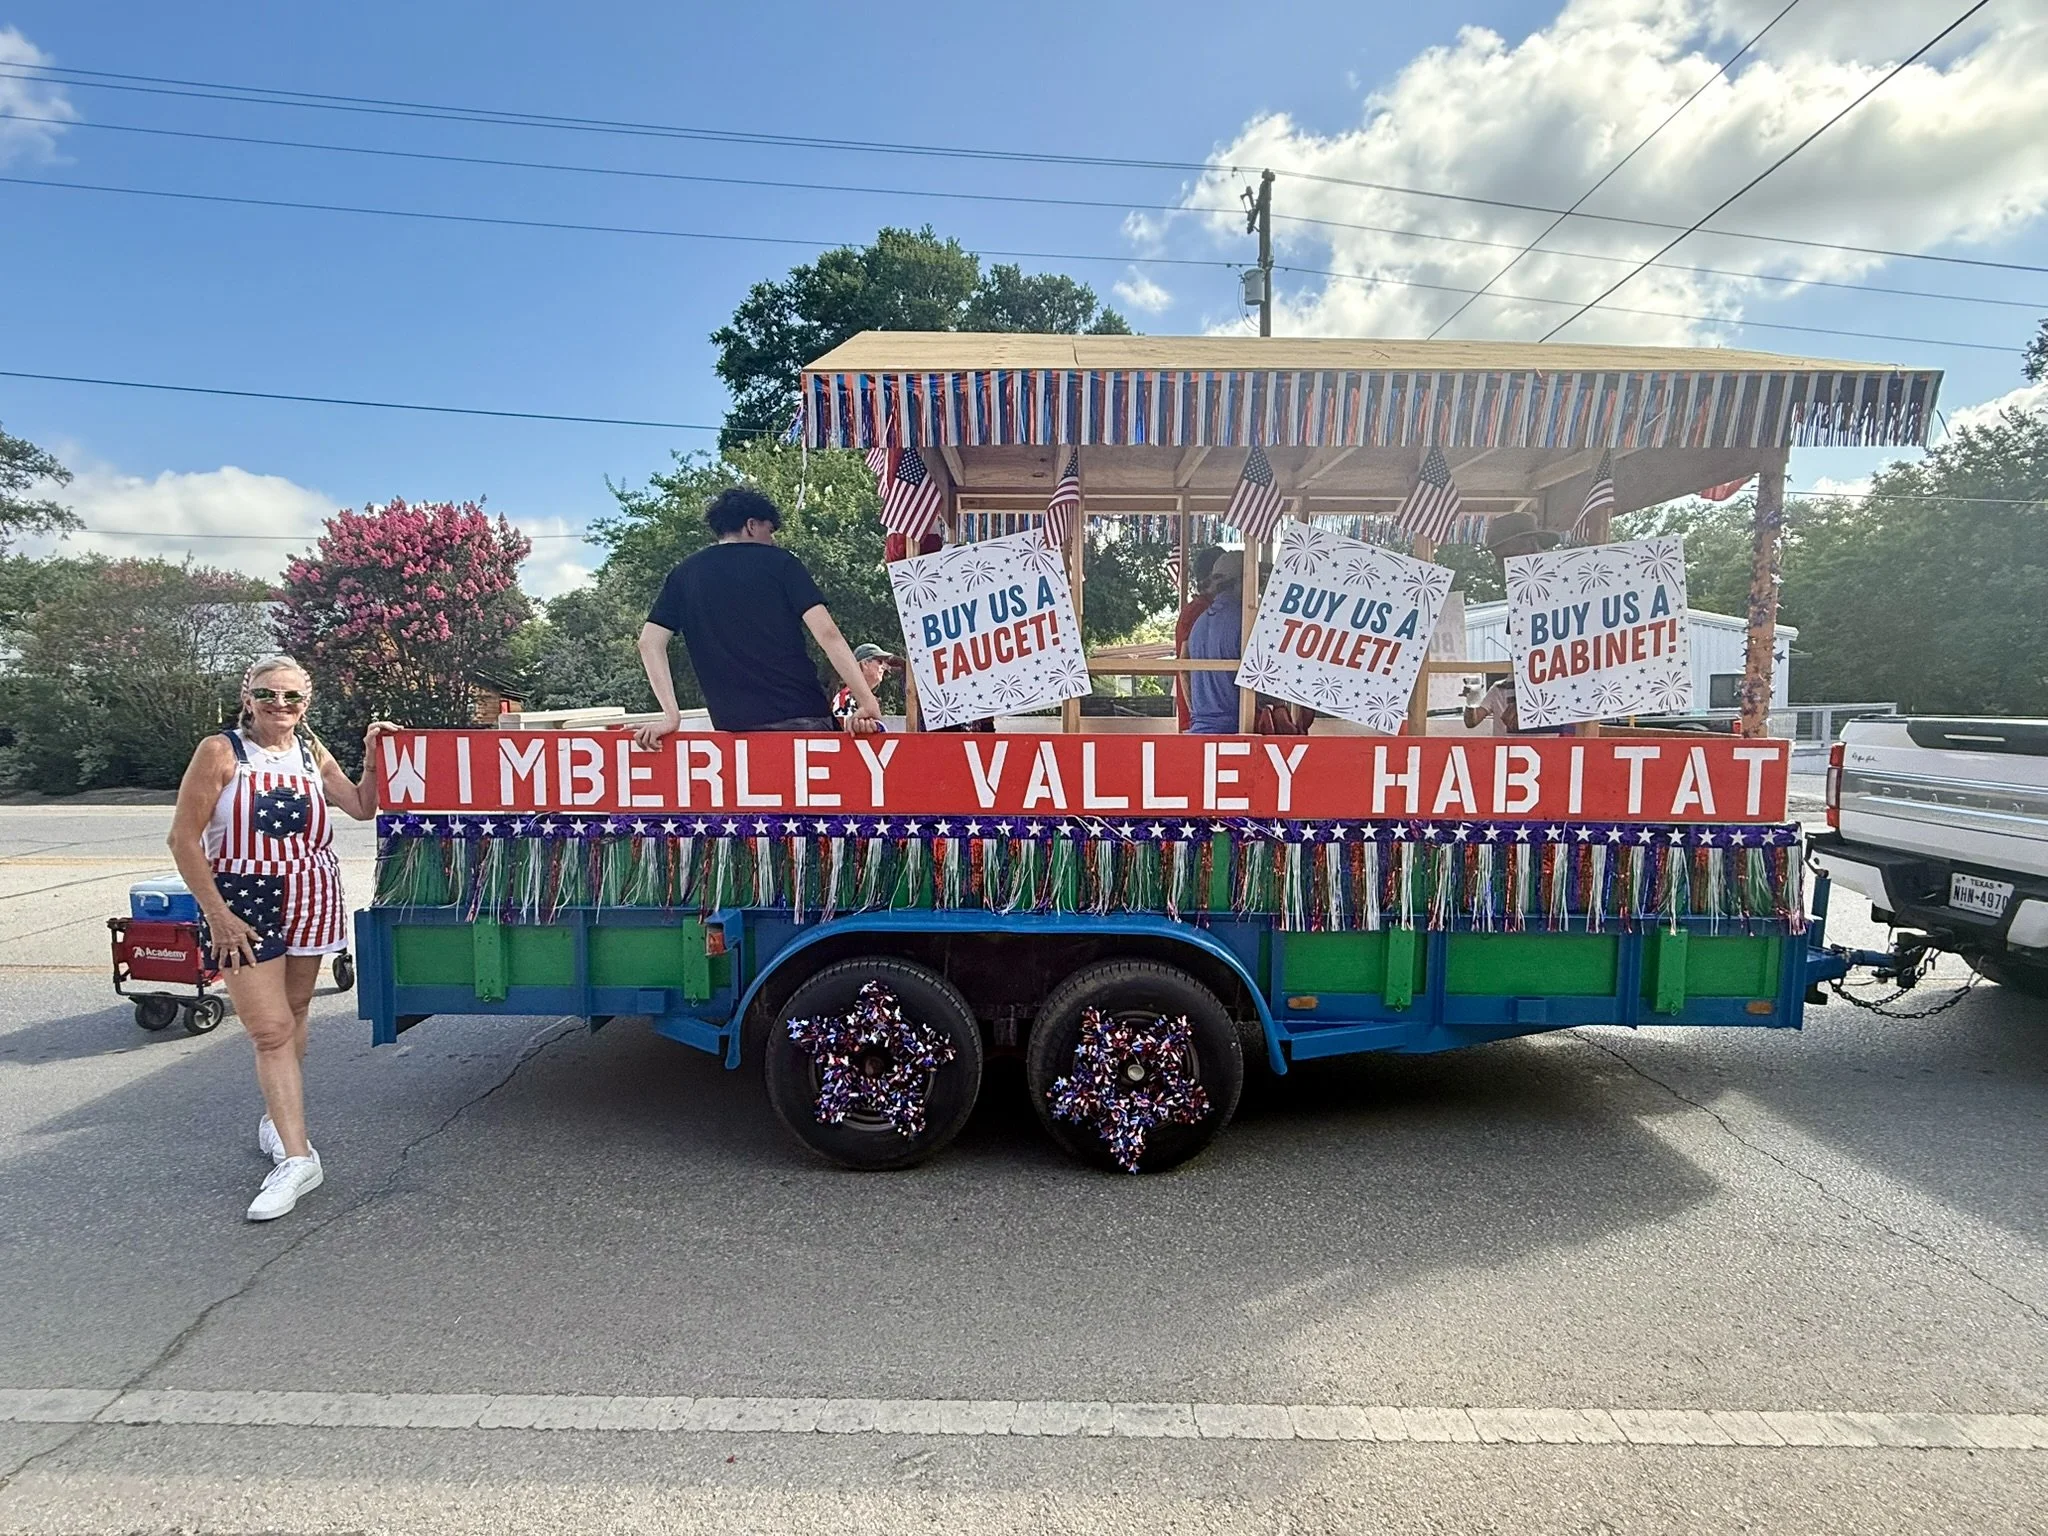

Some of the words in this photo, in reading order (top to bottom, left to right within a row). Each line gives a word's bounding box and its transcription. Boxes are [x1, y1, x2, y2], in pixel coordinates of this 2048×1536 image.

[921, 599, 978, 648] BUY
[989, 584, 1029, 624] US
[1037, 575, 1056, 610] A
[1279, 583, 1347, 623] BUY
[1350, 597, 1393, 634] US
[1394, 608, 1419, 641] A
[1531, 601, 1590, 647] BUY
[1602, 591, 1640, 629] US
[1650, 584, 1671, 619] A
[932, 610, 1060, 686] FAUCET!
[1278, 619, 1402, 676] TOILET!
[1528, 617, 1677, 685] CABINET!
[381, 734, 900, 809] WIMBERLEY
[964, 740, 1310, 813] VALLEY
[1370, 744, 1782, 816] HABITAT
[1970, 878, 1995, 890] TEXAS
[145, 946, 189, 961] Academy
